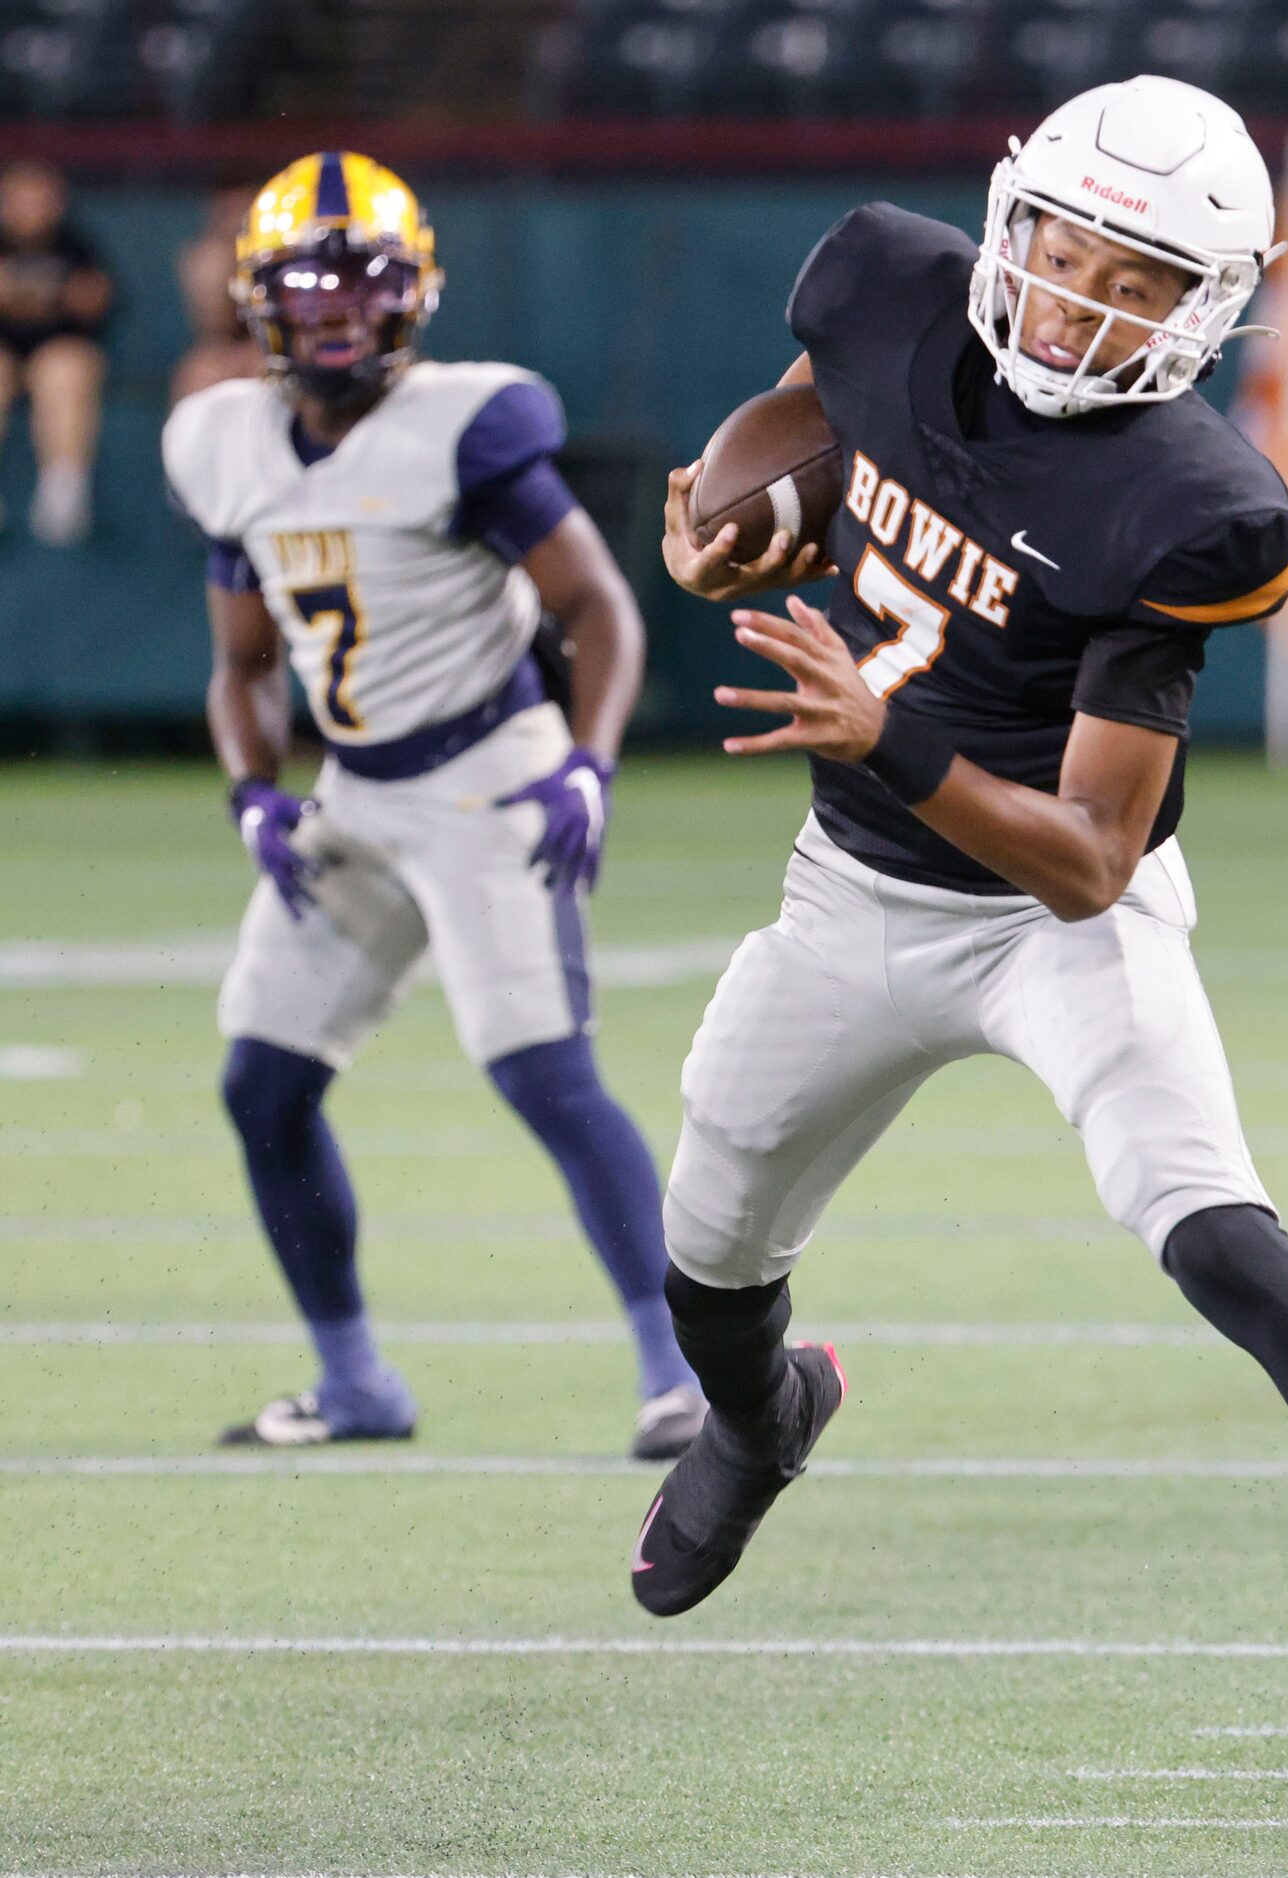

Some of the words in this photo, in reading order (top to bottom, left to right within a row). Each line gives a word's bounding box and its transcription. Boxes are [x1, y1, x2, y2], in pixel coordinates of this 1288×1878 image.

[1081, 175, 1148, 214] Riddell
[846, 450, 1019, 629] BOWIE
[288, 580, 367, 731] 7
[853, 542, 951, 702] 7
